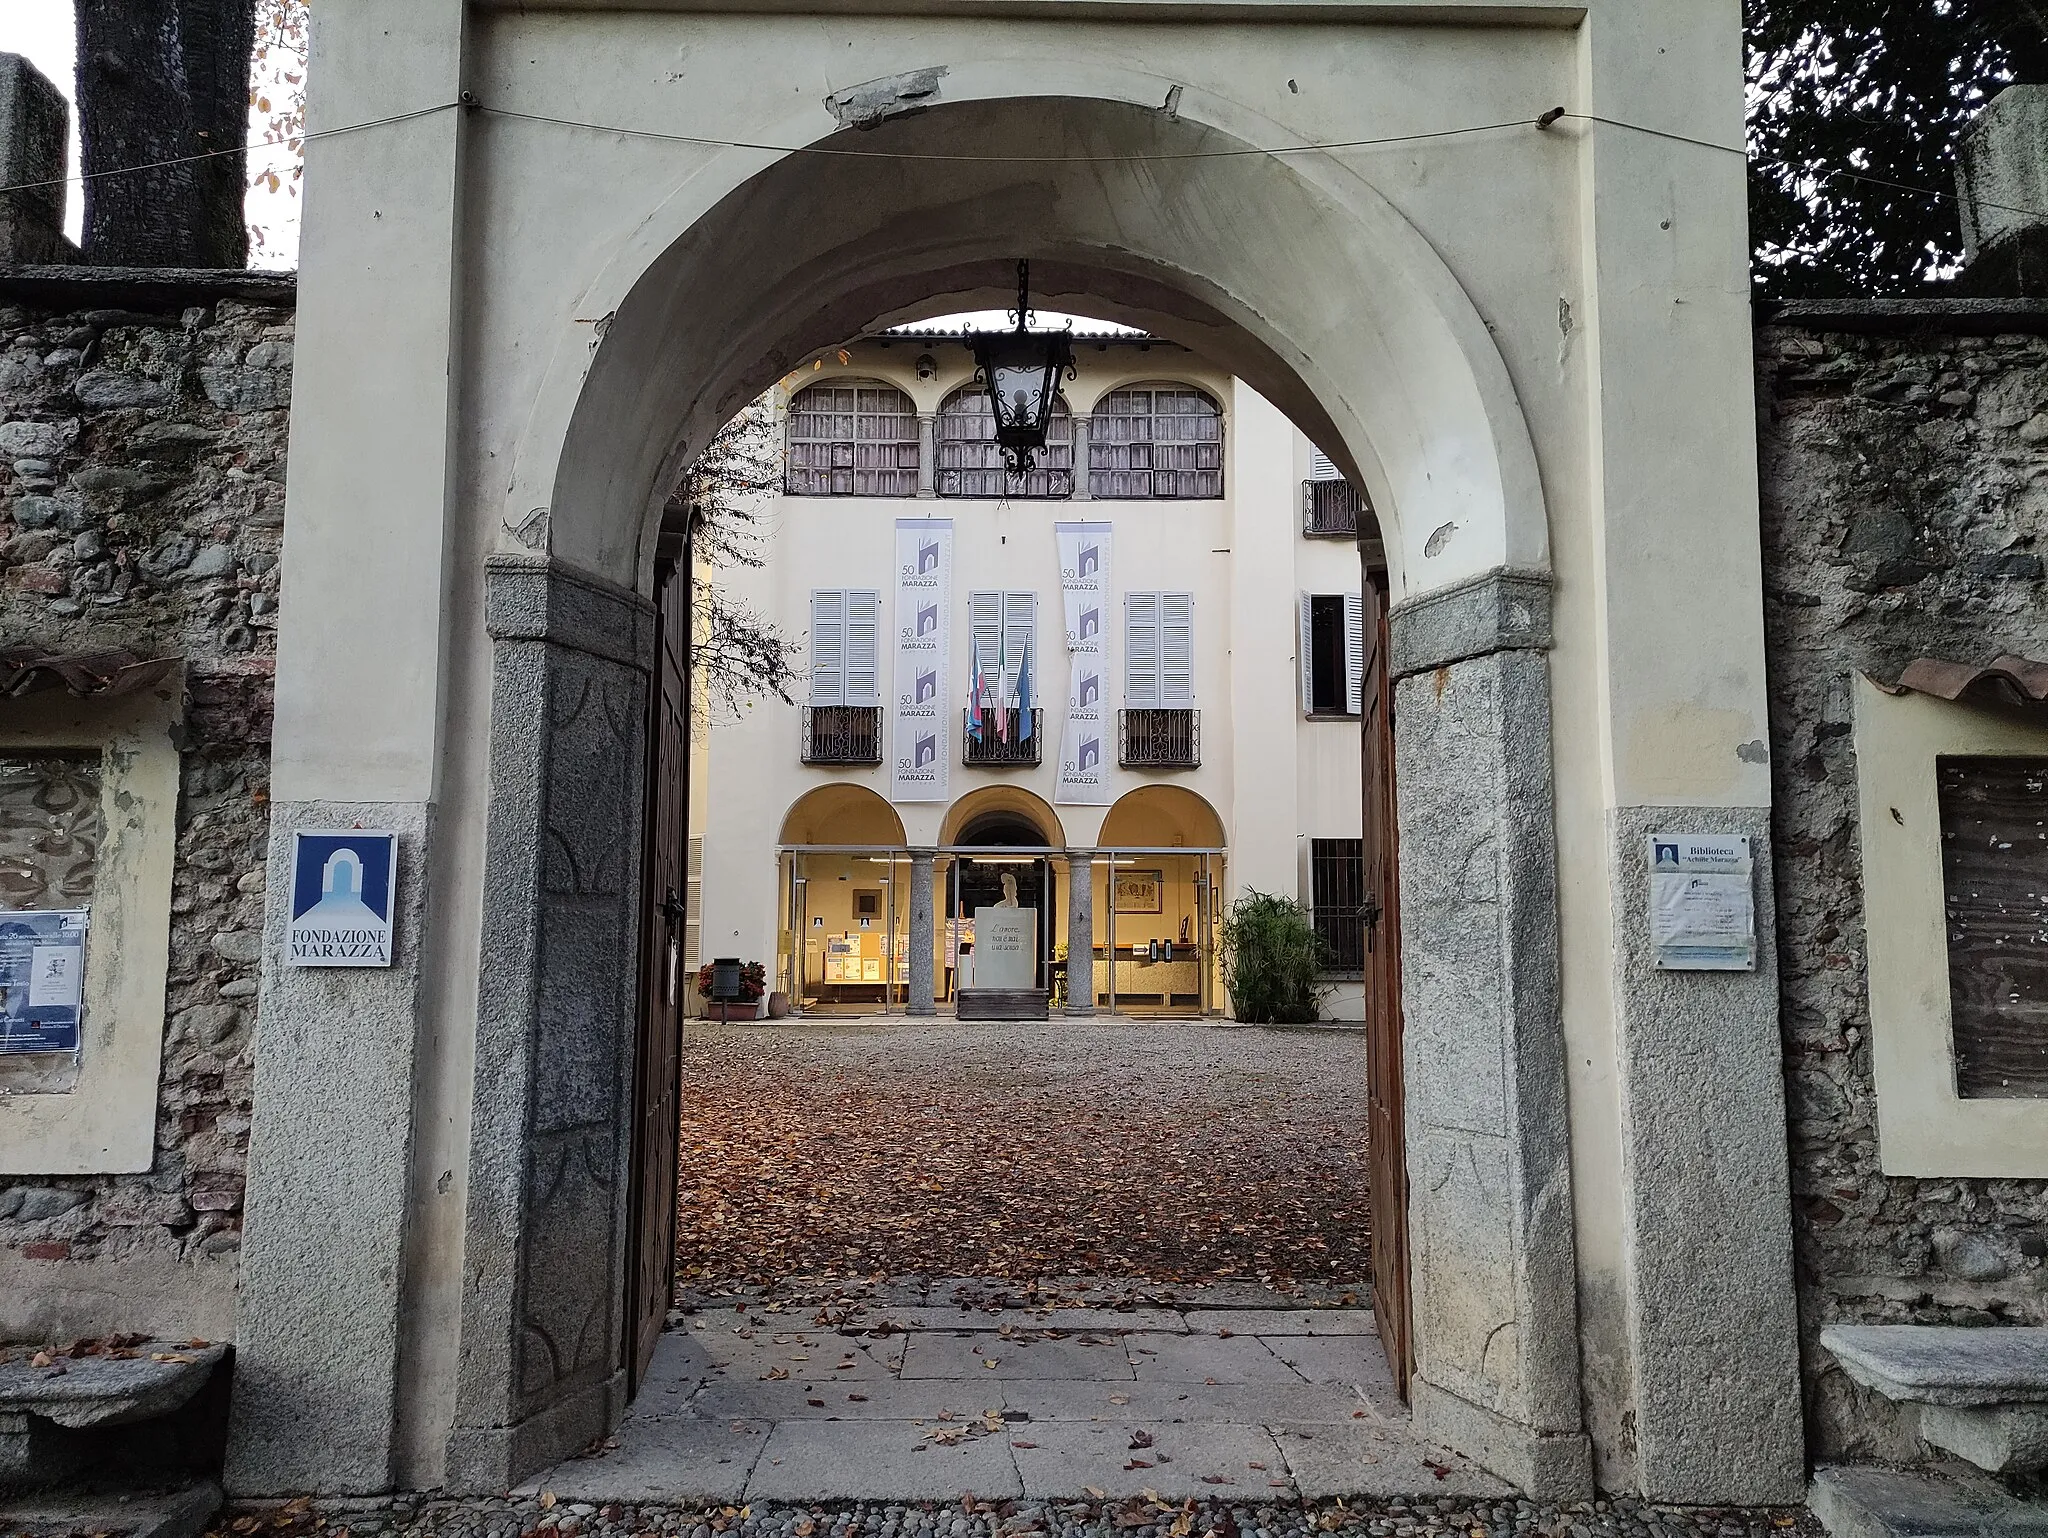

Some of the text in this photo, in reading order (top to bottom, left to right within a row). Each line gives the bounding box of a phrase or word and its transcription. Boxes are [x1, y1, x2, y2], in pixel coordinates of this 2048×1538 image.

[902, 565, 914, 575] 50
[1062, 569, 1075, 578] 50
[901, 628, 913, 637] 50
[900, 695, 912, 704] 50
[898, 759, 911, 768] 50
[1064, 761, 1075, 771] 50
[1690, 847, 1734, 856] Biblioteca
[292, 929, 386, 944] FONDAZIONE
[291, 944, 385, 958] MARAZZA
